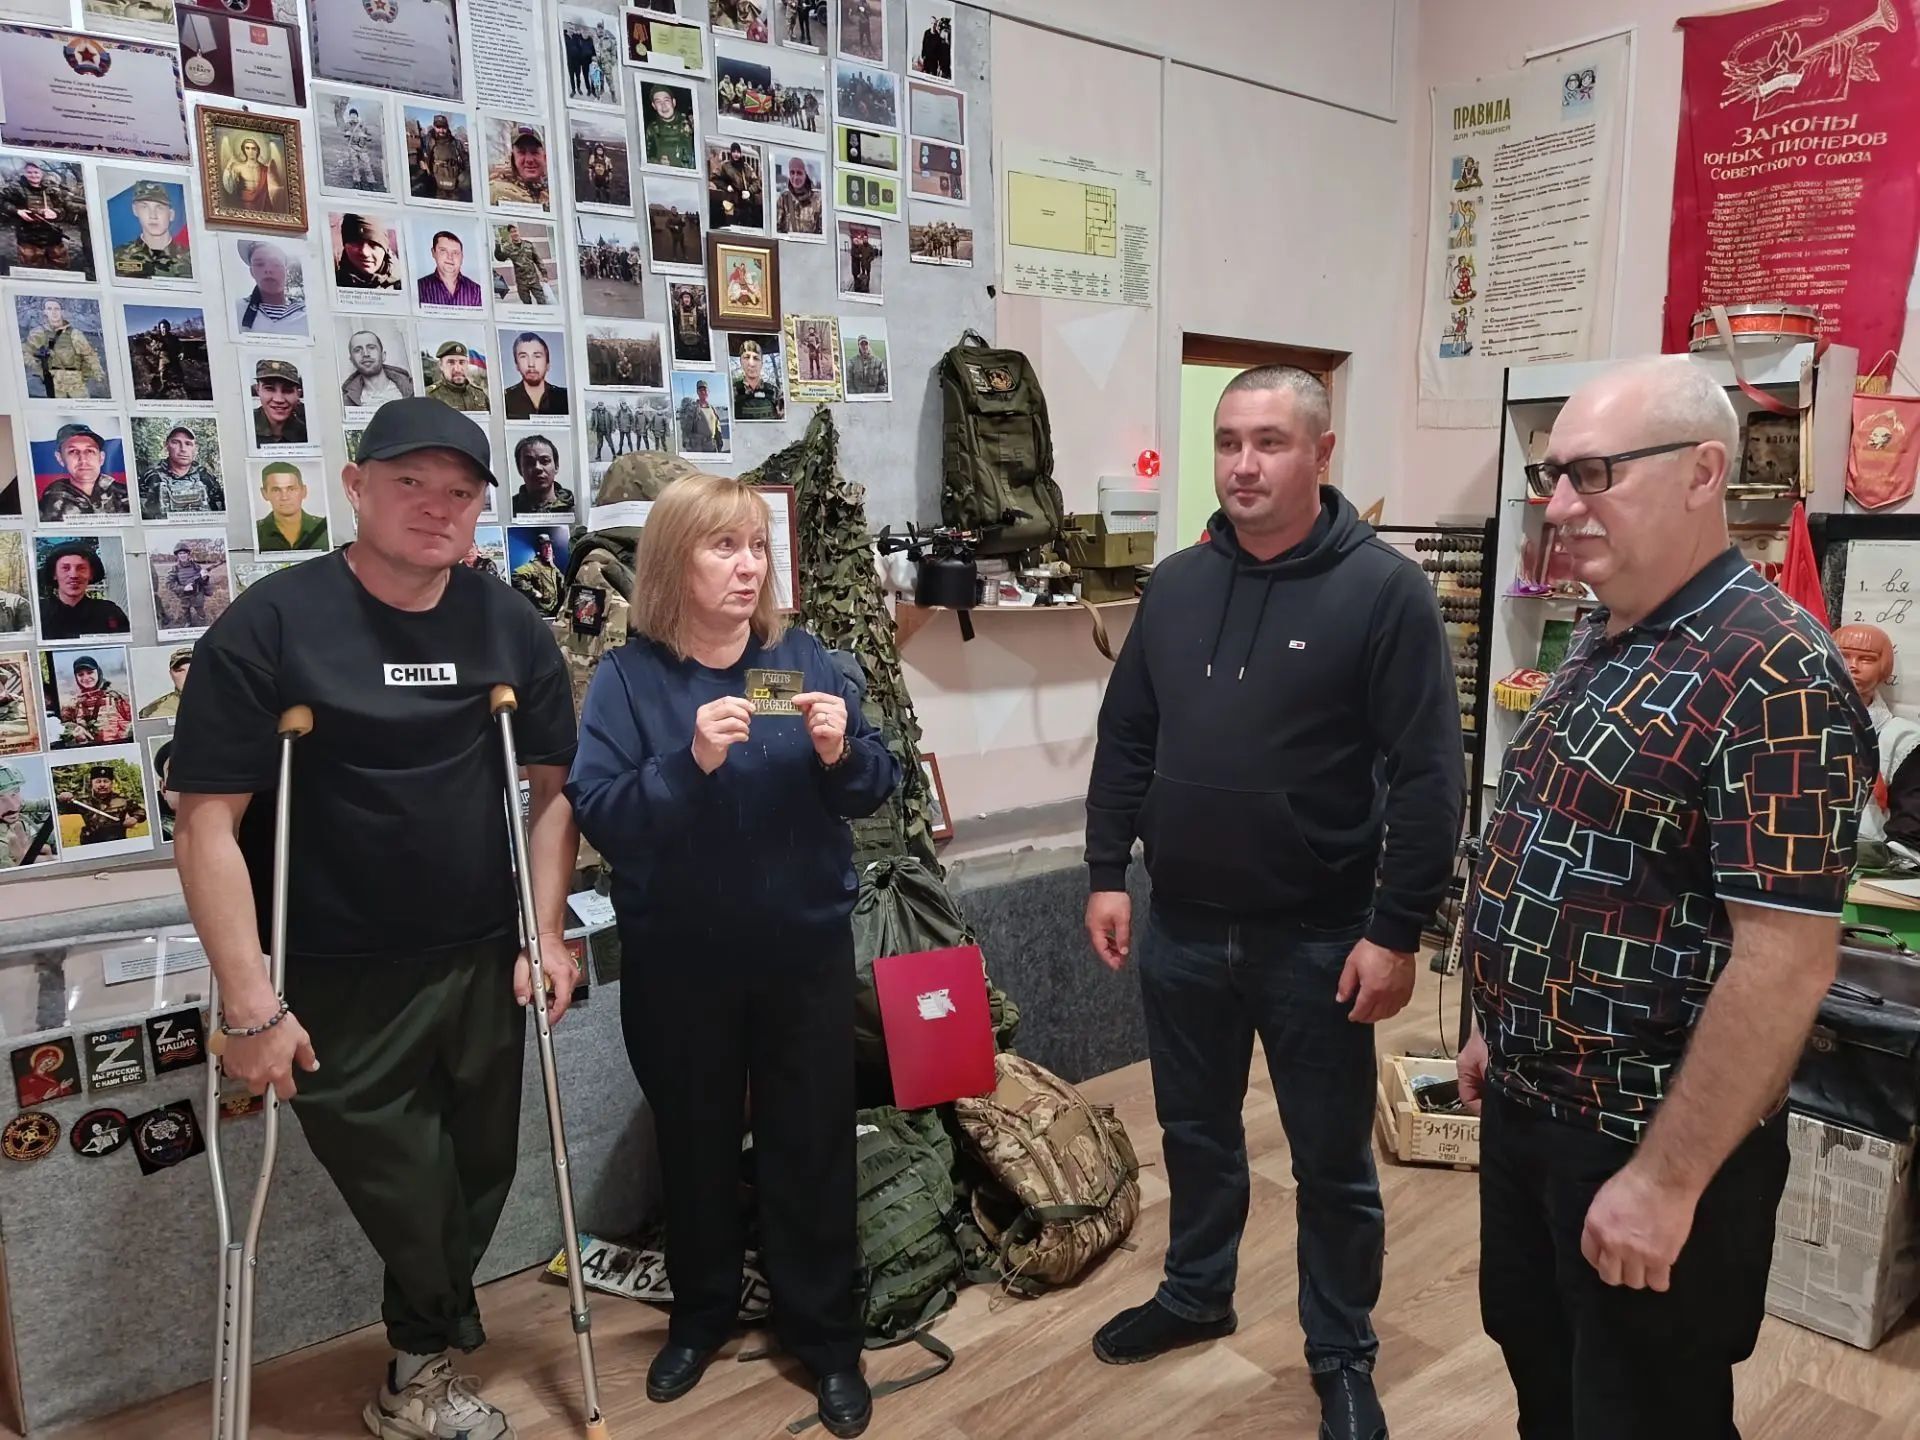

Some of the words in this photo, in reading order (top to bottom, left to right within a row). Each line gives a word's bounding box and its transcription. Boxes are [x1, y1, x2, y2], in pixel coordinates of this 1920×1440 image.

[1453, 98, 1511, 130] ПРАВИЛА
[1453, 132, 1468, 141] для
[1732, 114, 1858, 147] ЗАКОНЫ
[1704, 147, 1764, 165] ЮНЫХ
[1771, 132, 1887, 156] ПИОНЕРОВ
[1854, 611, 1865, 622] 2.
[390, 667, 451, 682] CHILL
[158, 1037, 198, 1054] НАШИХ
[94, 1038, 138, 1073] Z
[122, 1072, 141, 1082] БОГ.
